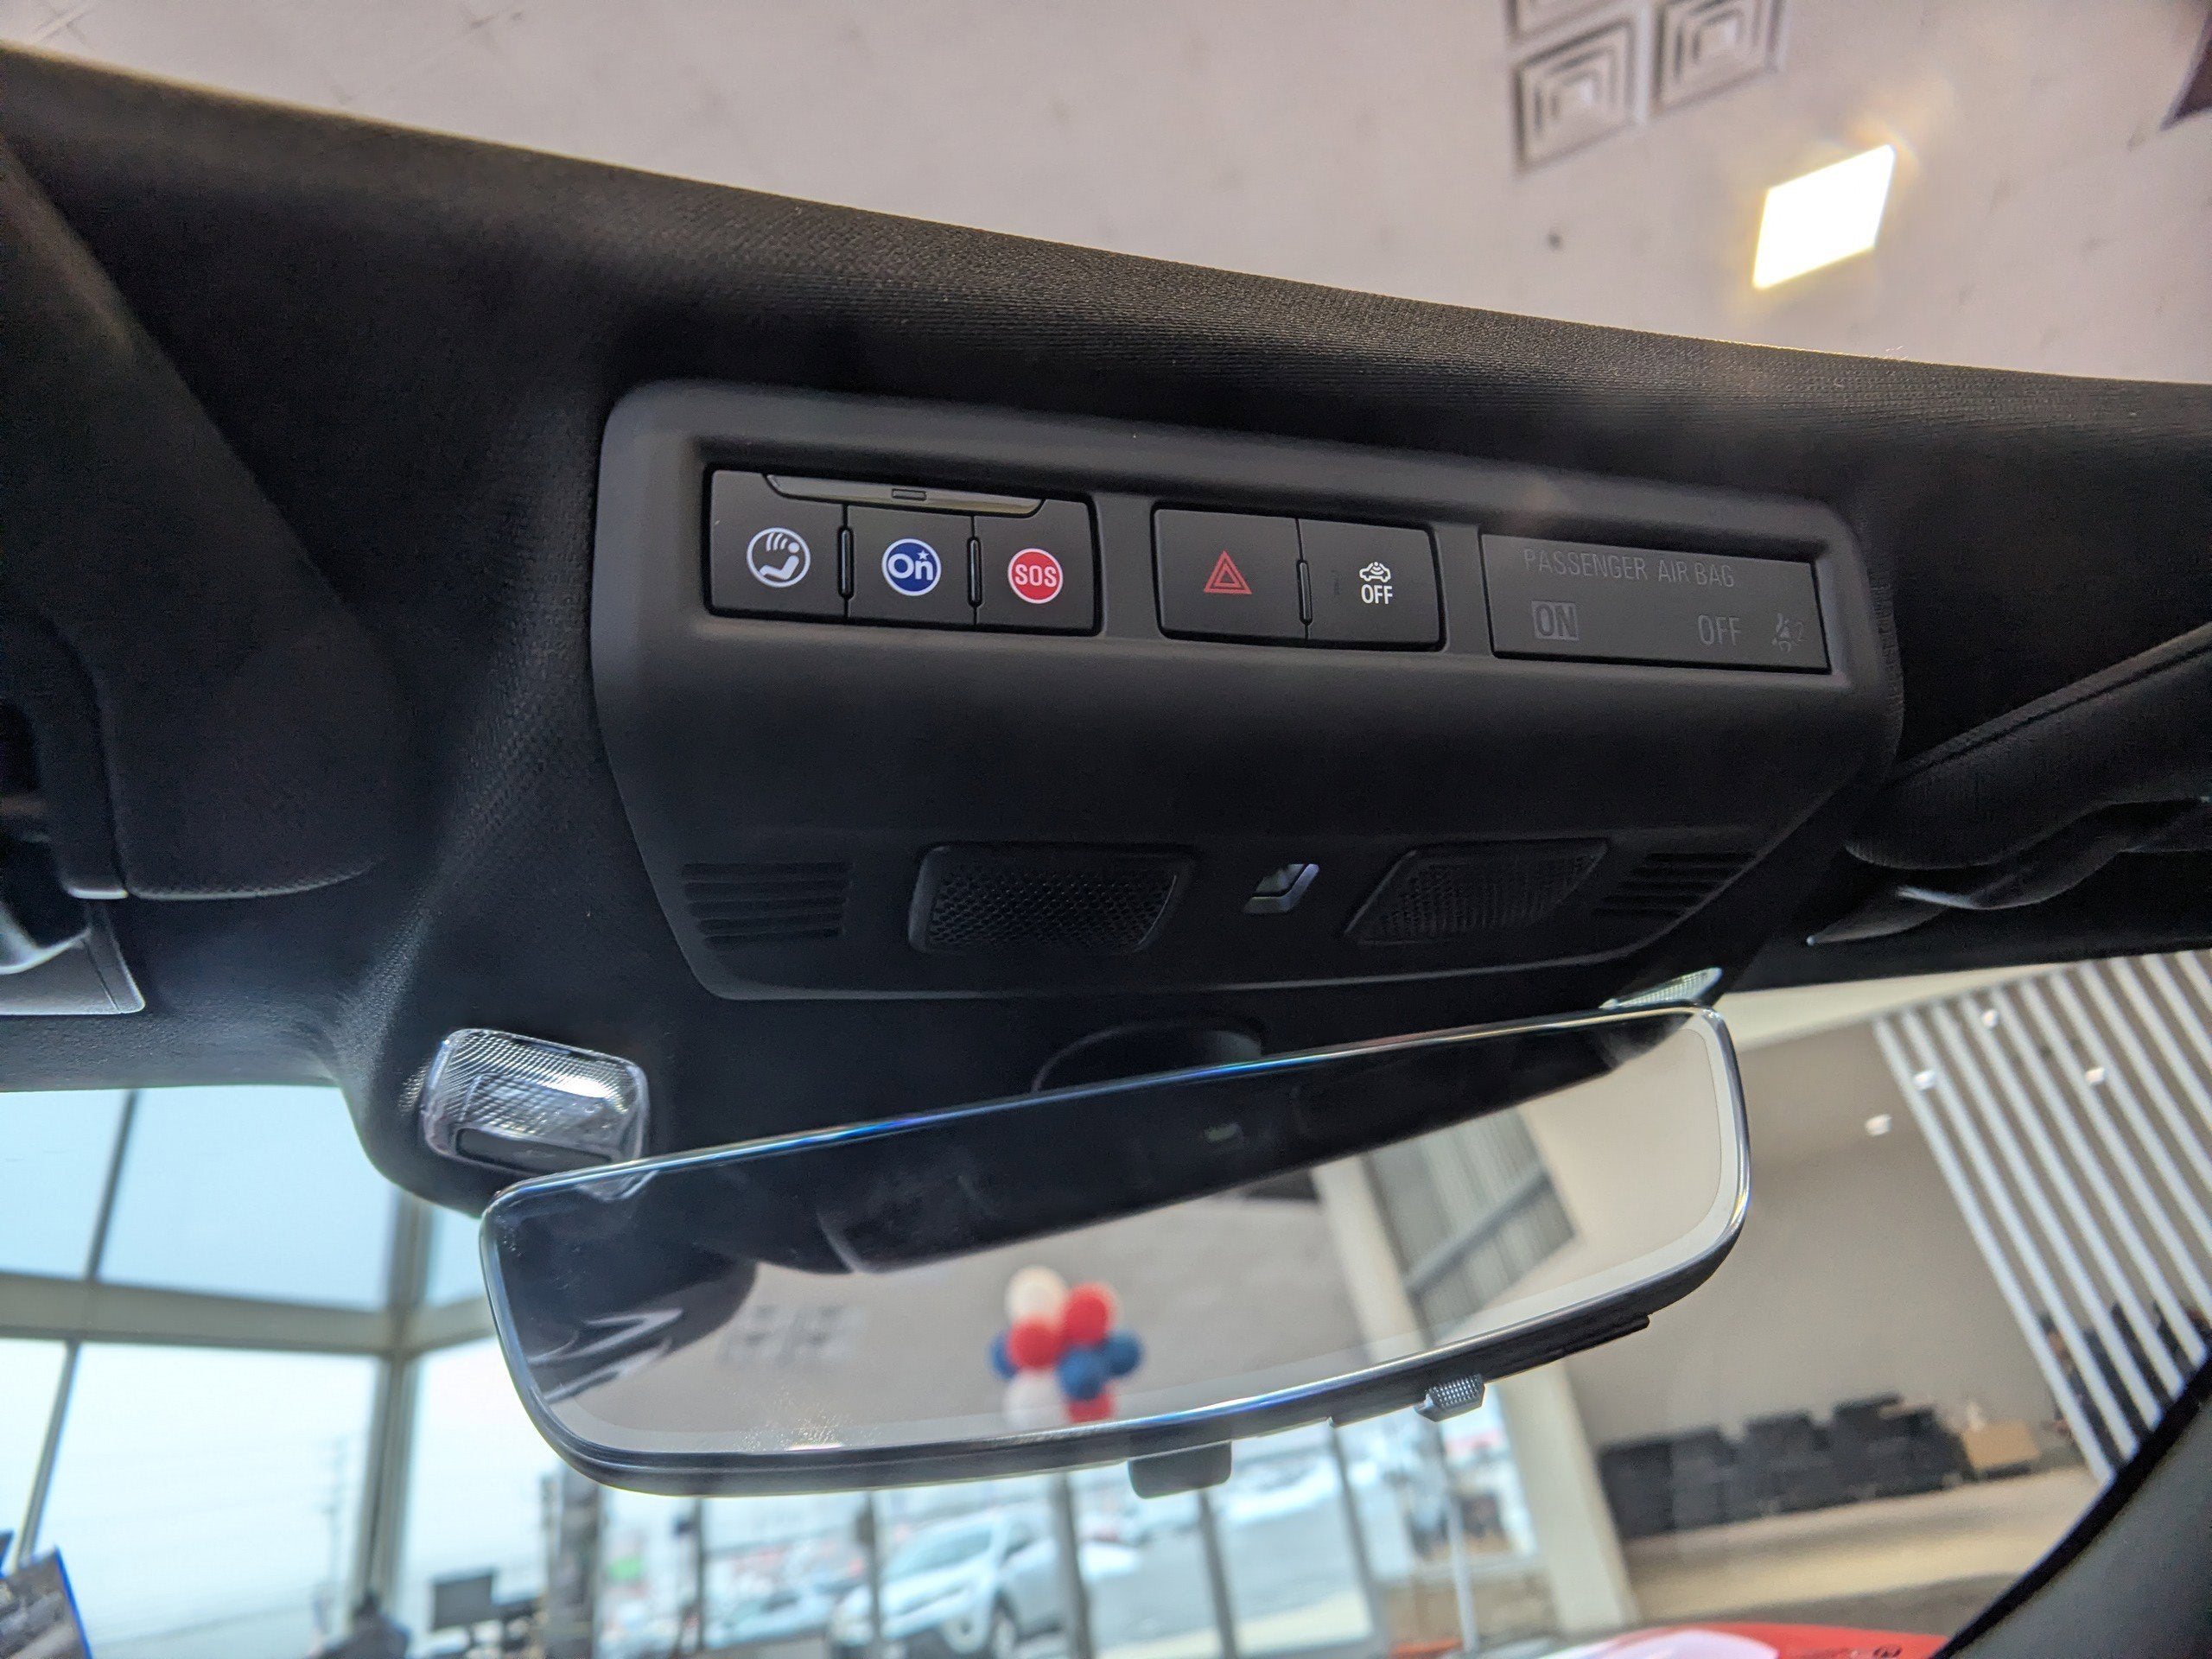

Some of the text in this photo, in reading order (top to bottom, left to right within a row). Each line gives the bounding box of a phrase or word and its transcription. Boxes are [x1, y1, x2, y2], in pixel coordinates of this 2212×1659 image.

[887, 552, 934, 580] On
[1014, 563, 1058, 588] SOS
[1523, 549, 1735, 587] PASSENGER AIR BAG
[1361, 584, 1393, 605] OFF
[1534, 604, 1578, 638] ON
[1697, 614, 1741, 646] OFF
